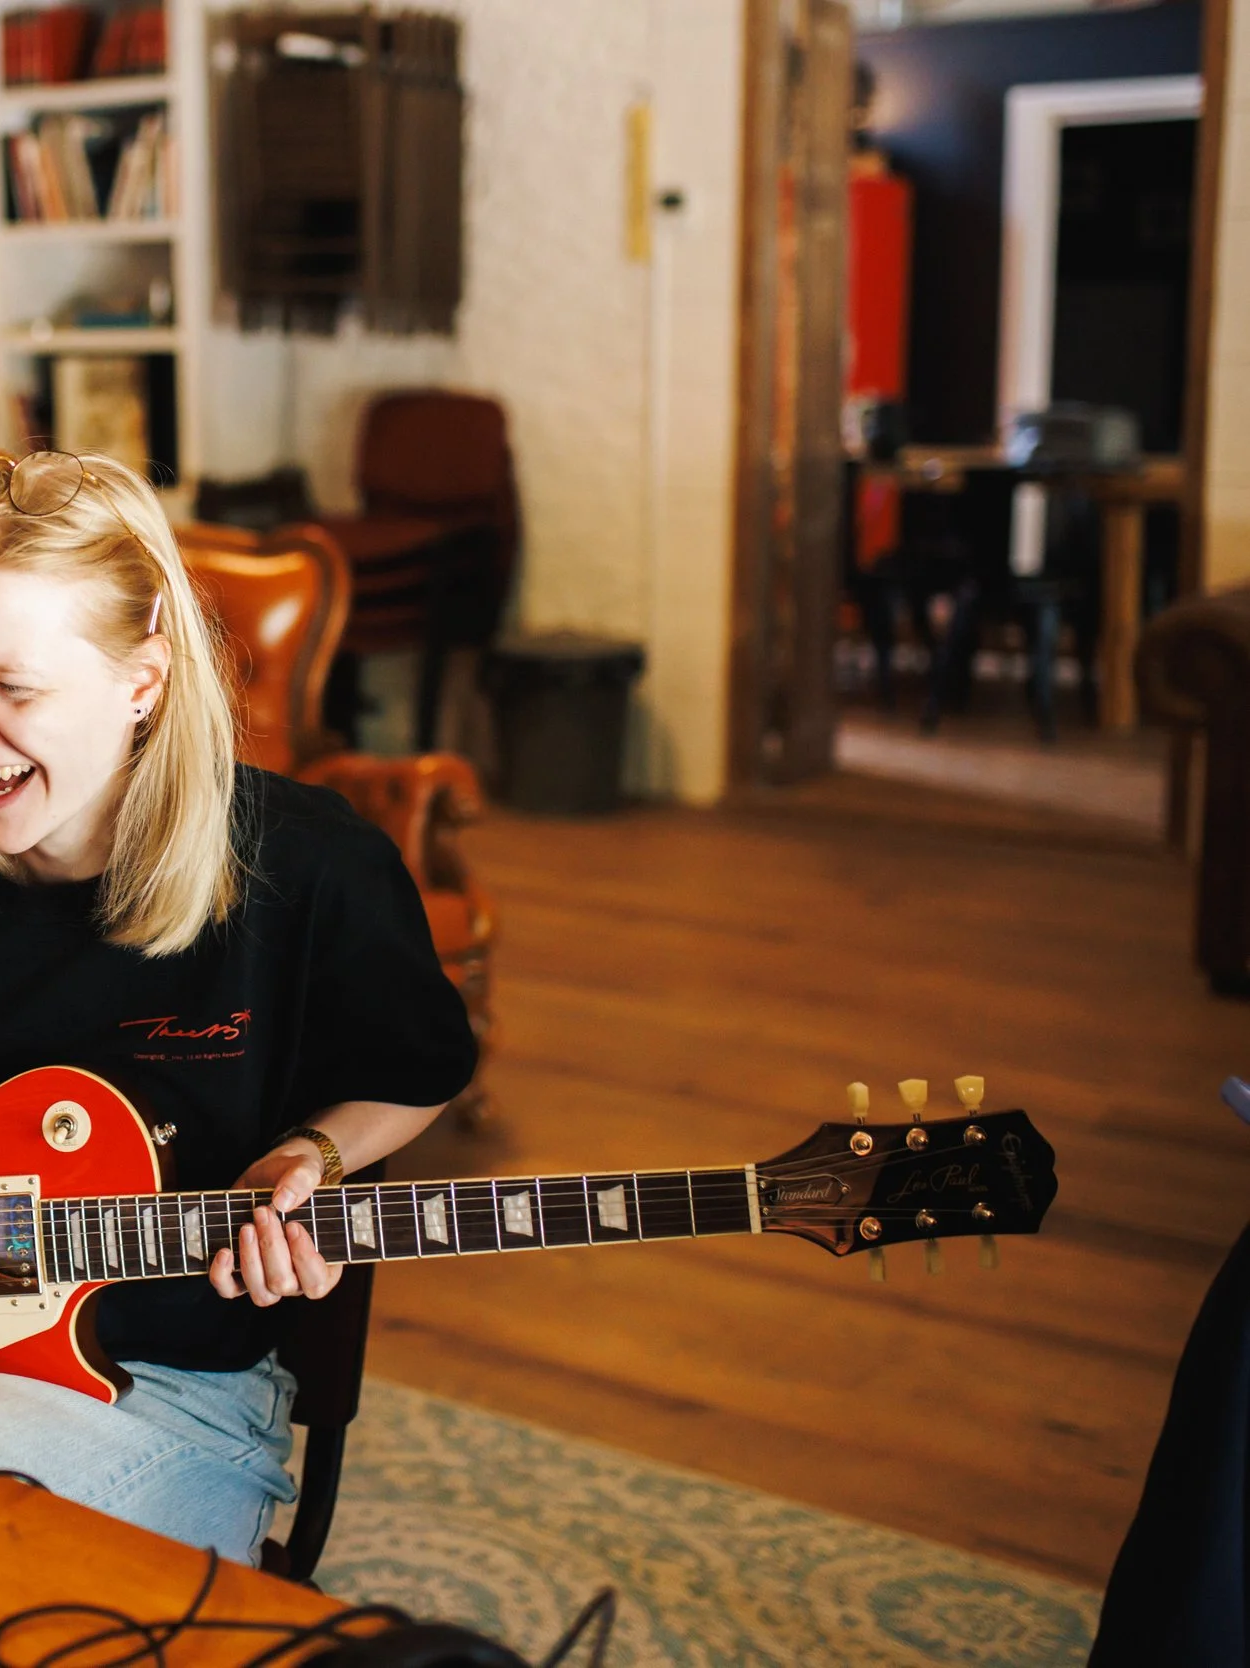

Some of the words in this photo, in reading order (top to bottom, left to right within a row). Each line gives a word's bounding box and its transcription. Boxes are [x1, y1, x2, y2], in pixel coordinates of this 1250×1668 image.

[768, 1180, 833, 1202] Standard
[886, 1170, 928, 1204] Les
[930, 1163, 980, 1193] Paul
